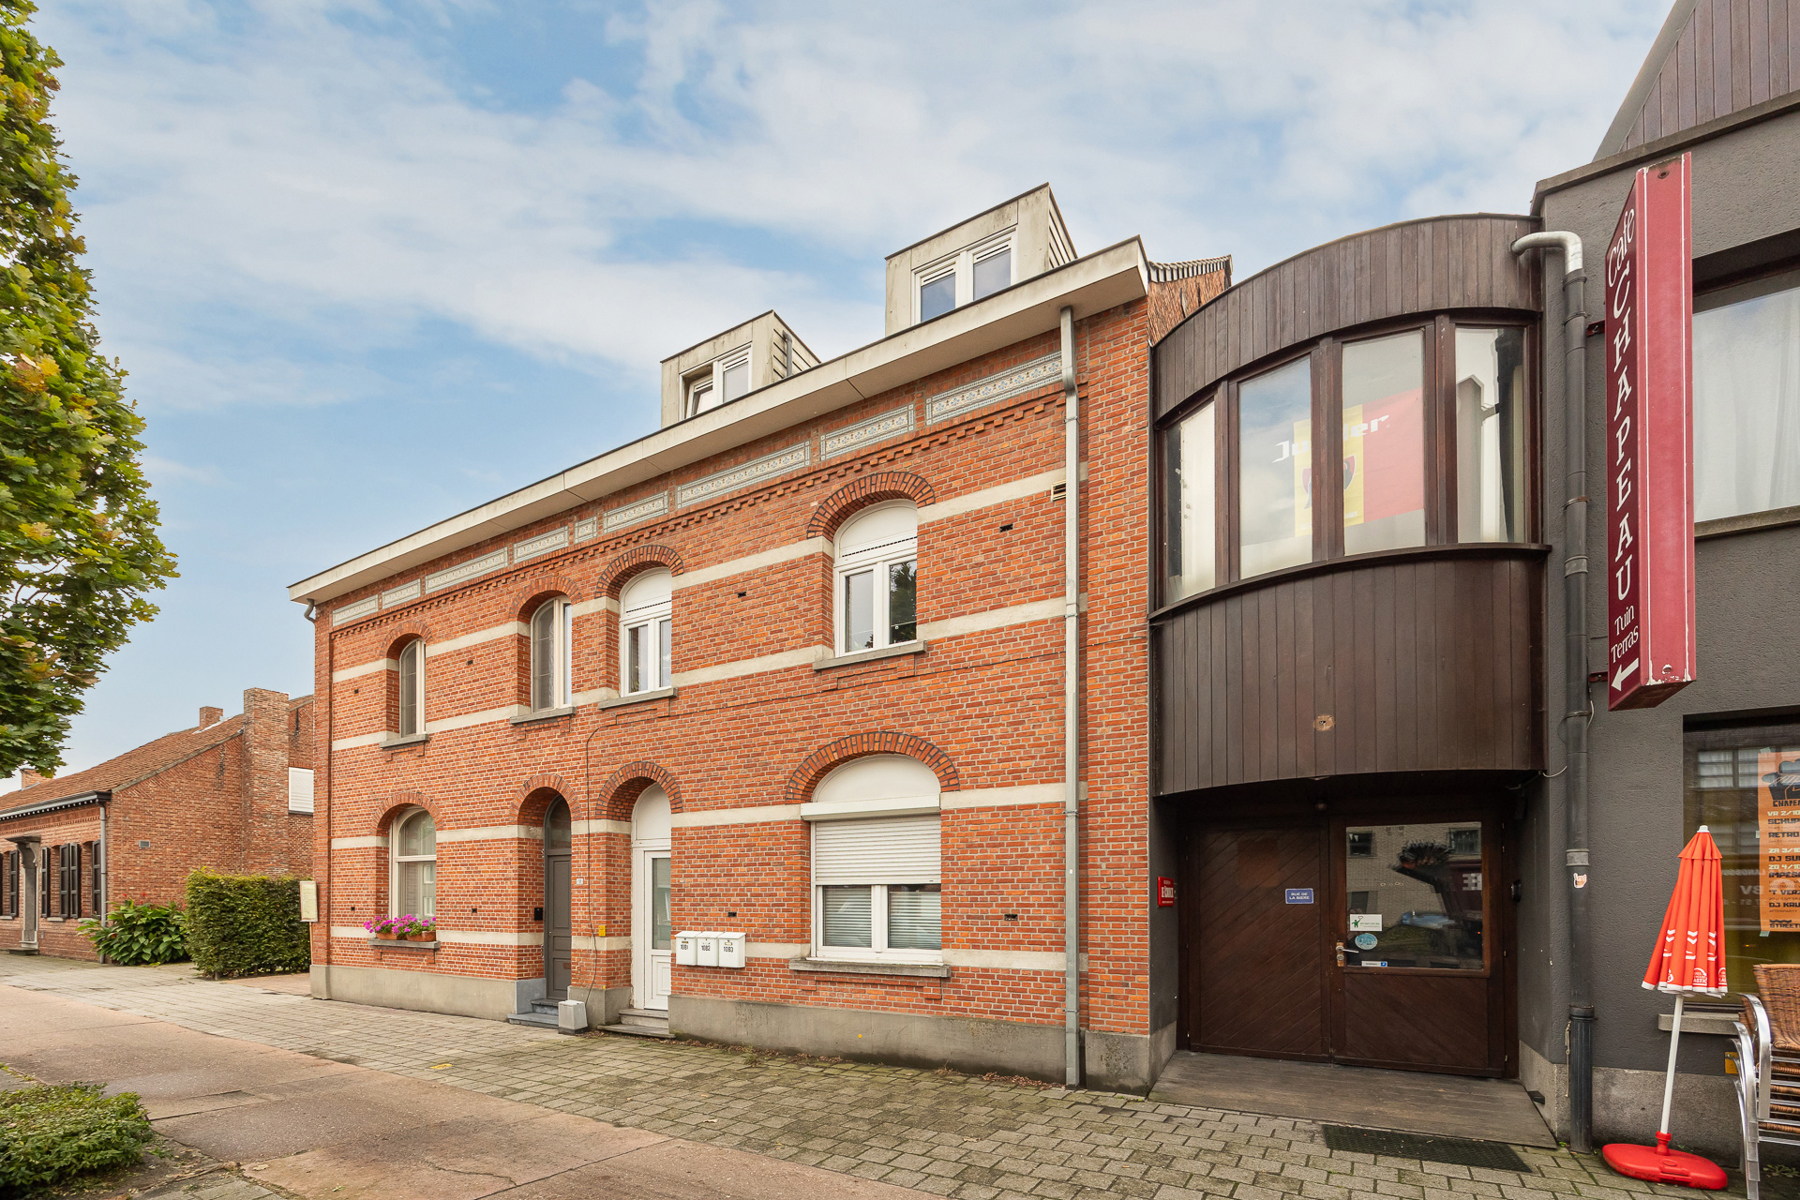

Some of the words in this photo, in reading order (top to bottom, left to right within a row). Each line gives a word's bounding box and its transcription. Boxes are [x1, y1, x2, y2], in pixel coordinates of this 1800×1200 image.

[1271, 414, 1389, 464] Juler
[1613, 260, 1633, 601] CHAPEAU
[1614, 604, 1635, 636] Tuin
[1610, 626, 1639, 664] Terras
[1772, 799, 1800, 807] CHAPE
